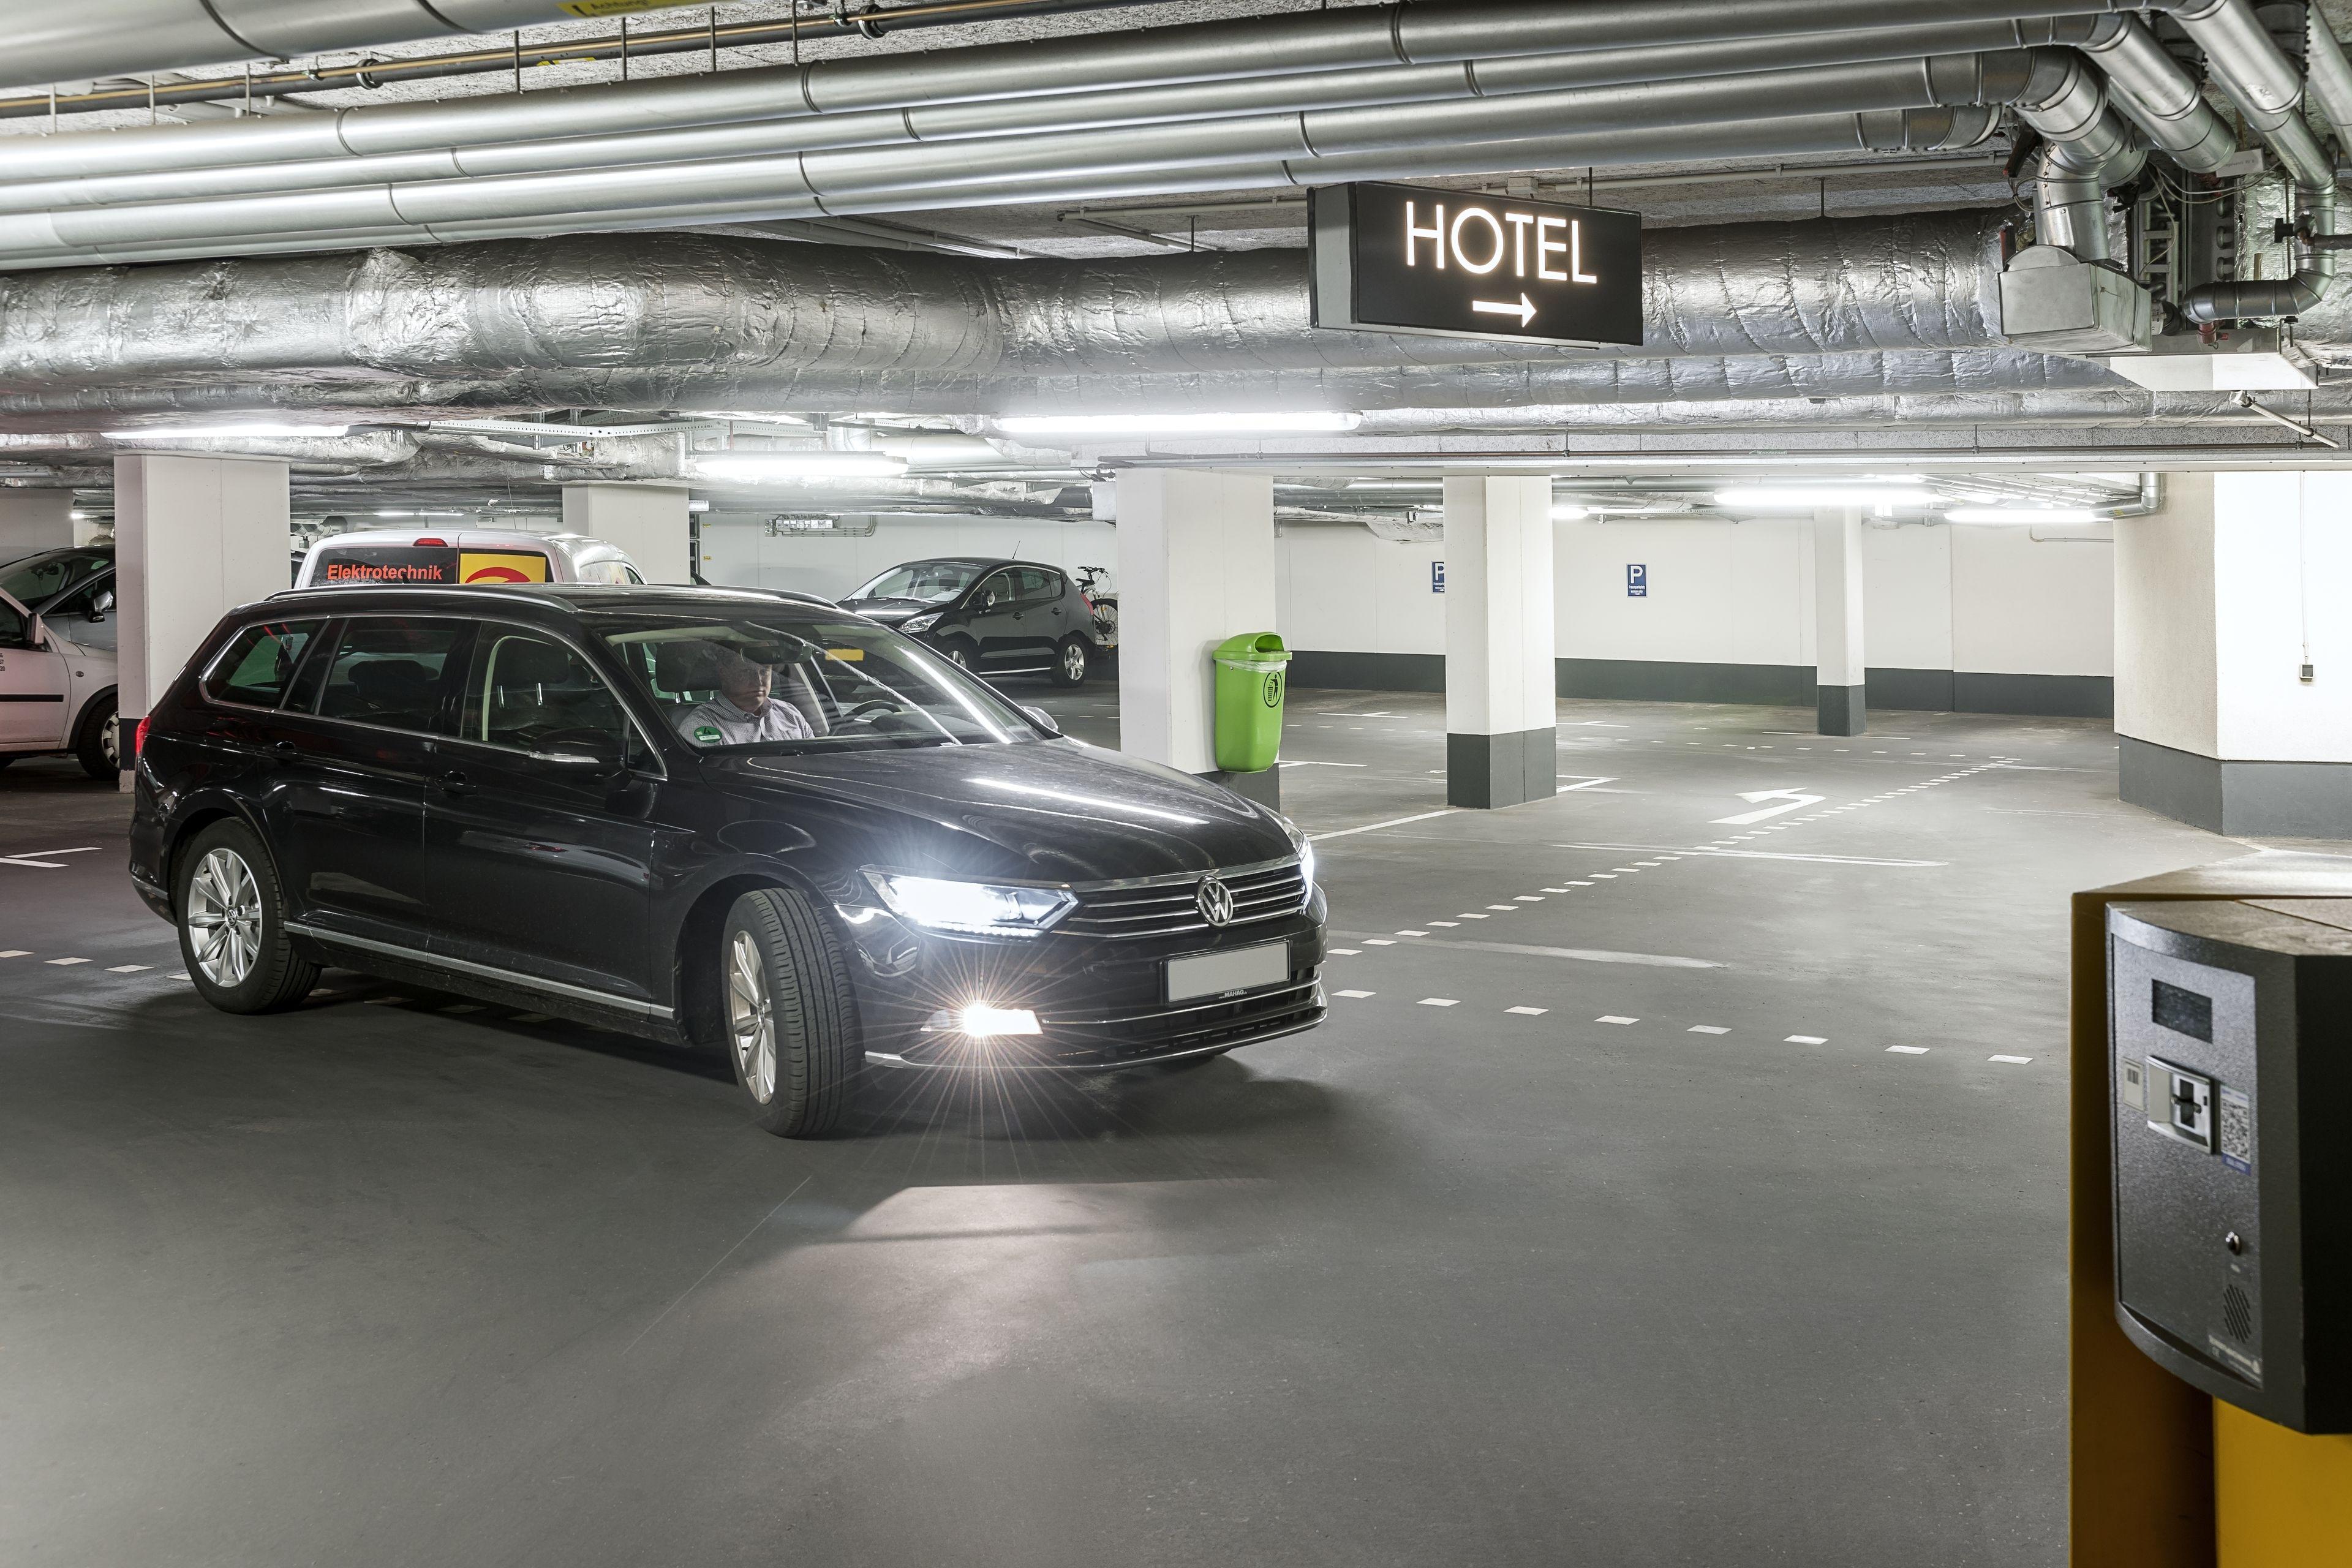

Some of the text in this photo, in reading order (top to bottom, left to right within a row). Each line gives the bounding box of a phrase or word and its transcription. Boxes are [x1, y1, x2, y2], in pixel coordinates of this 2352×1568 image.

[1406, 202, 1597, 284] HOTEL
[328, 565, 442, 580] Elektrotechnik
[1435, 563, 1444, 581] P
[1630, 565, 1643, 584] P
